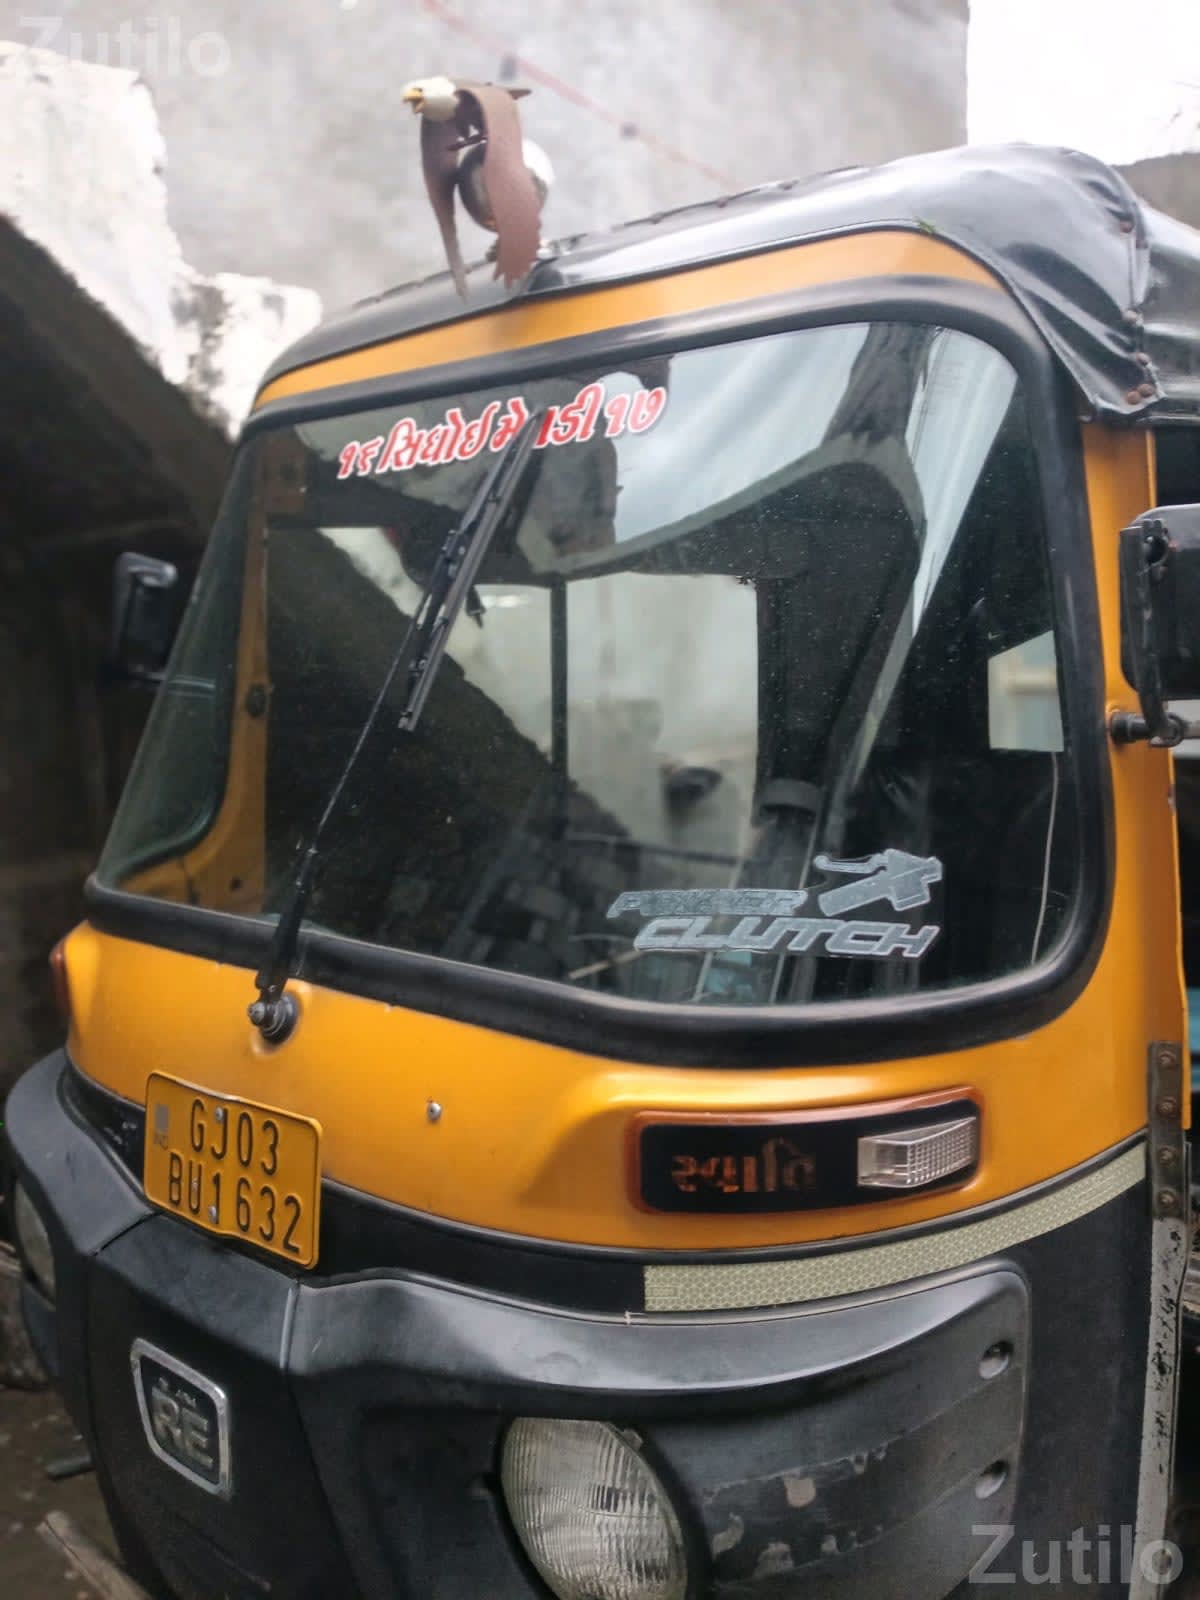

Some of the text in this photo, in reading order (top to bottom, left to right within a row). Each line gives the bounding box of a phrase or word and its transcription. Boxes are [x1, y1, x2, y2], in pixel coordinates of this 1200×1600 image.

[633, 916, 940, 957] CLUTCH
[189, 1098, 279, 1177] GJ03
[168, 1151, 302, 1254] BU1632
